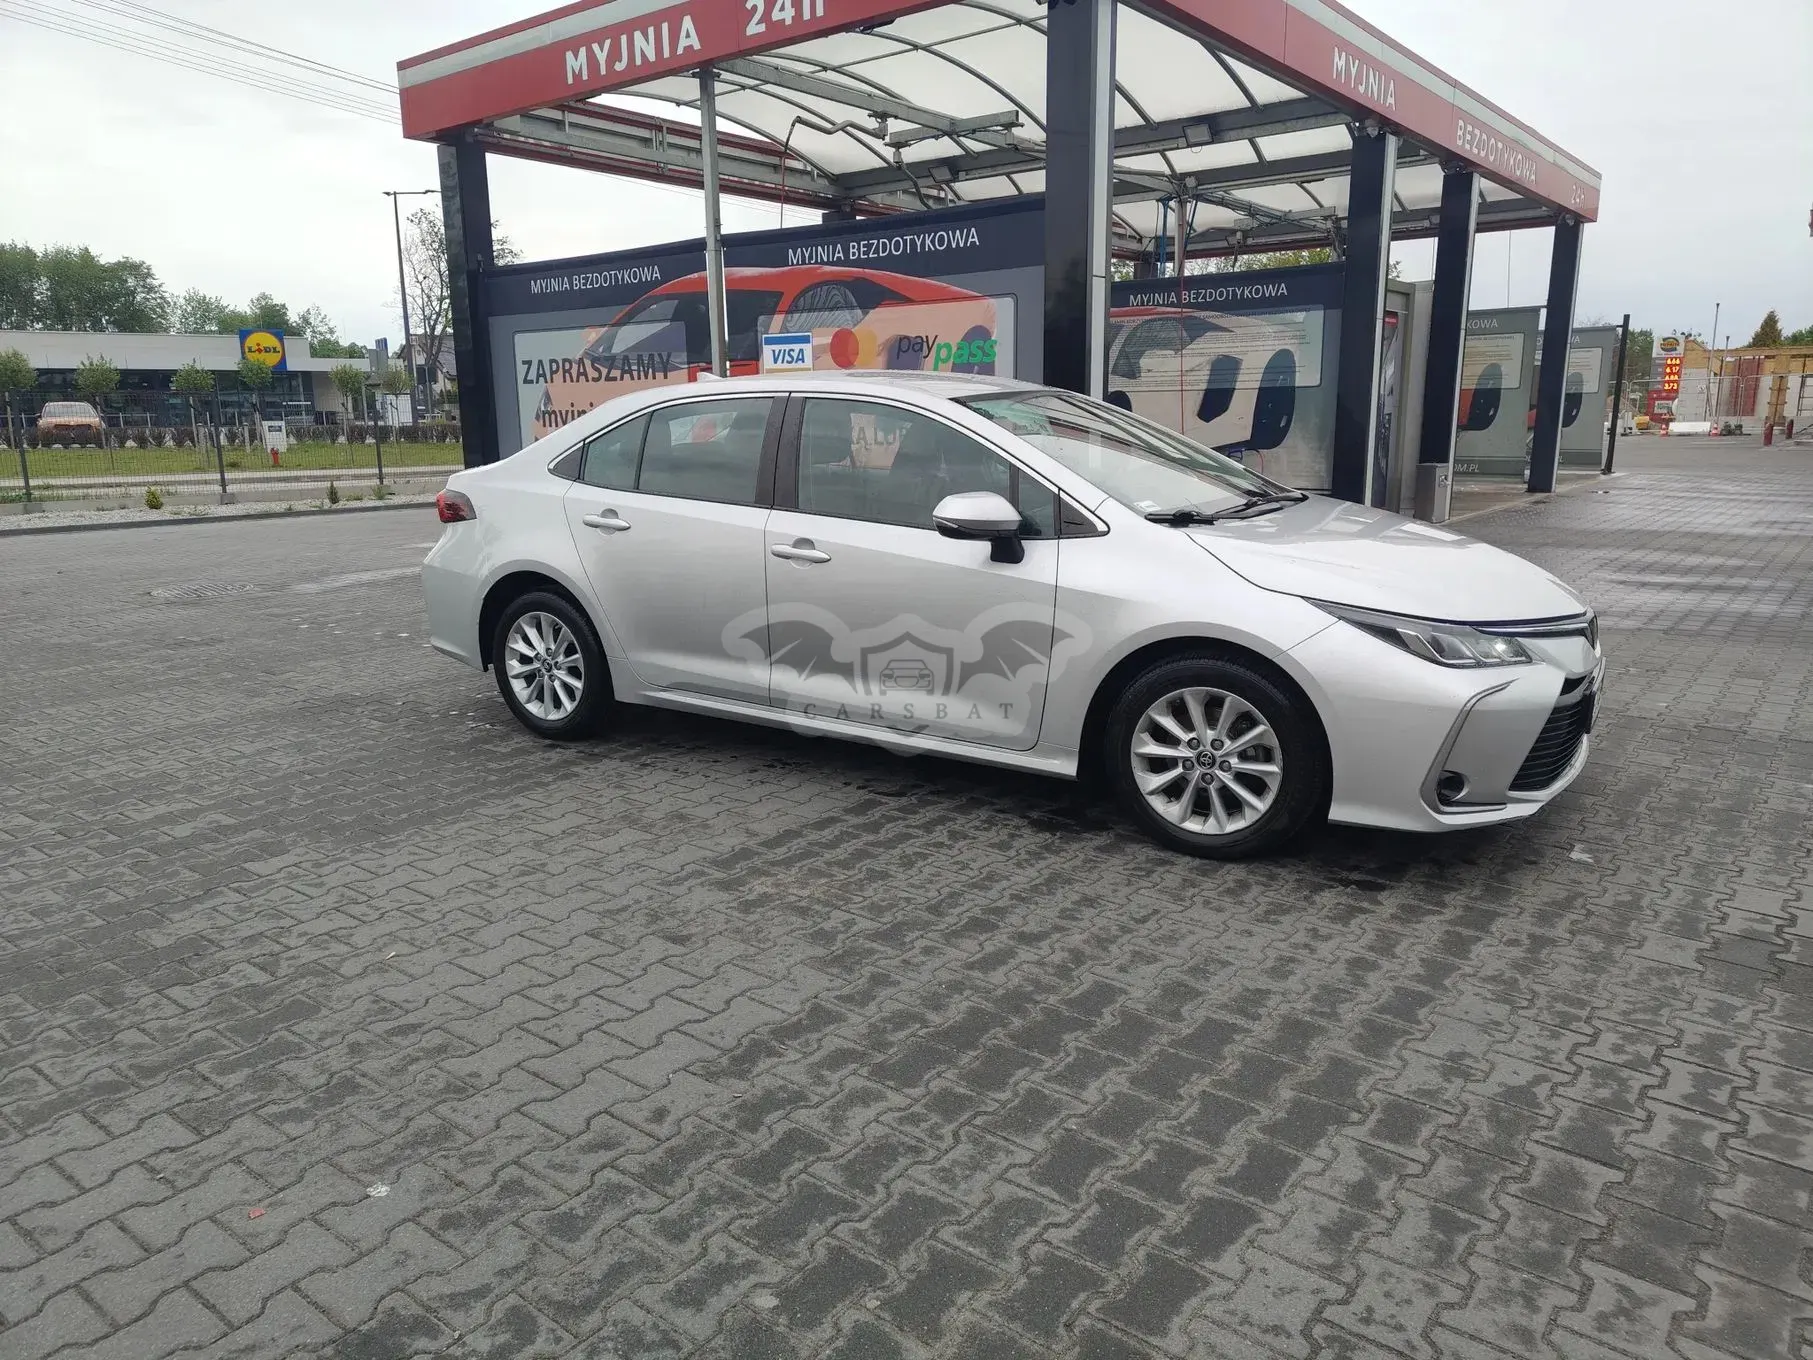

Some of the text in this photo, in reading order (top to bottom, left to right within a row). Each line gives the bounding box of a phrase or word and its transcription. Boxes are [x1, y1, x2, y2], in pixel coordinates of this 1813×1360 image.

[565, 15, 701, 85] MYJNIA
[1333, 47, 1397, 111] MYJNIA
[1456, 119, 1537, 185] BEZDOTYKOWA
[788, 227, 980, 265] MYJNIA BEZDOTYKOWA
[530, 264, 661, 294] MYJNIA BEZDOTYKOWA
[1129, 282, 1288, 307] MYJNIA BEZDOTYKOWA
[521, 352, 672, 385] ZAPRASZAMY
[772, 348, 806, 365] VISA
